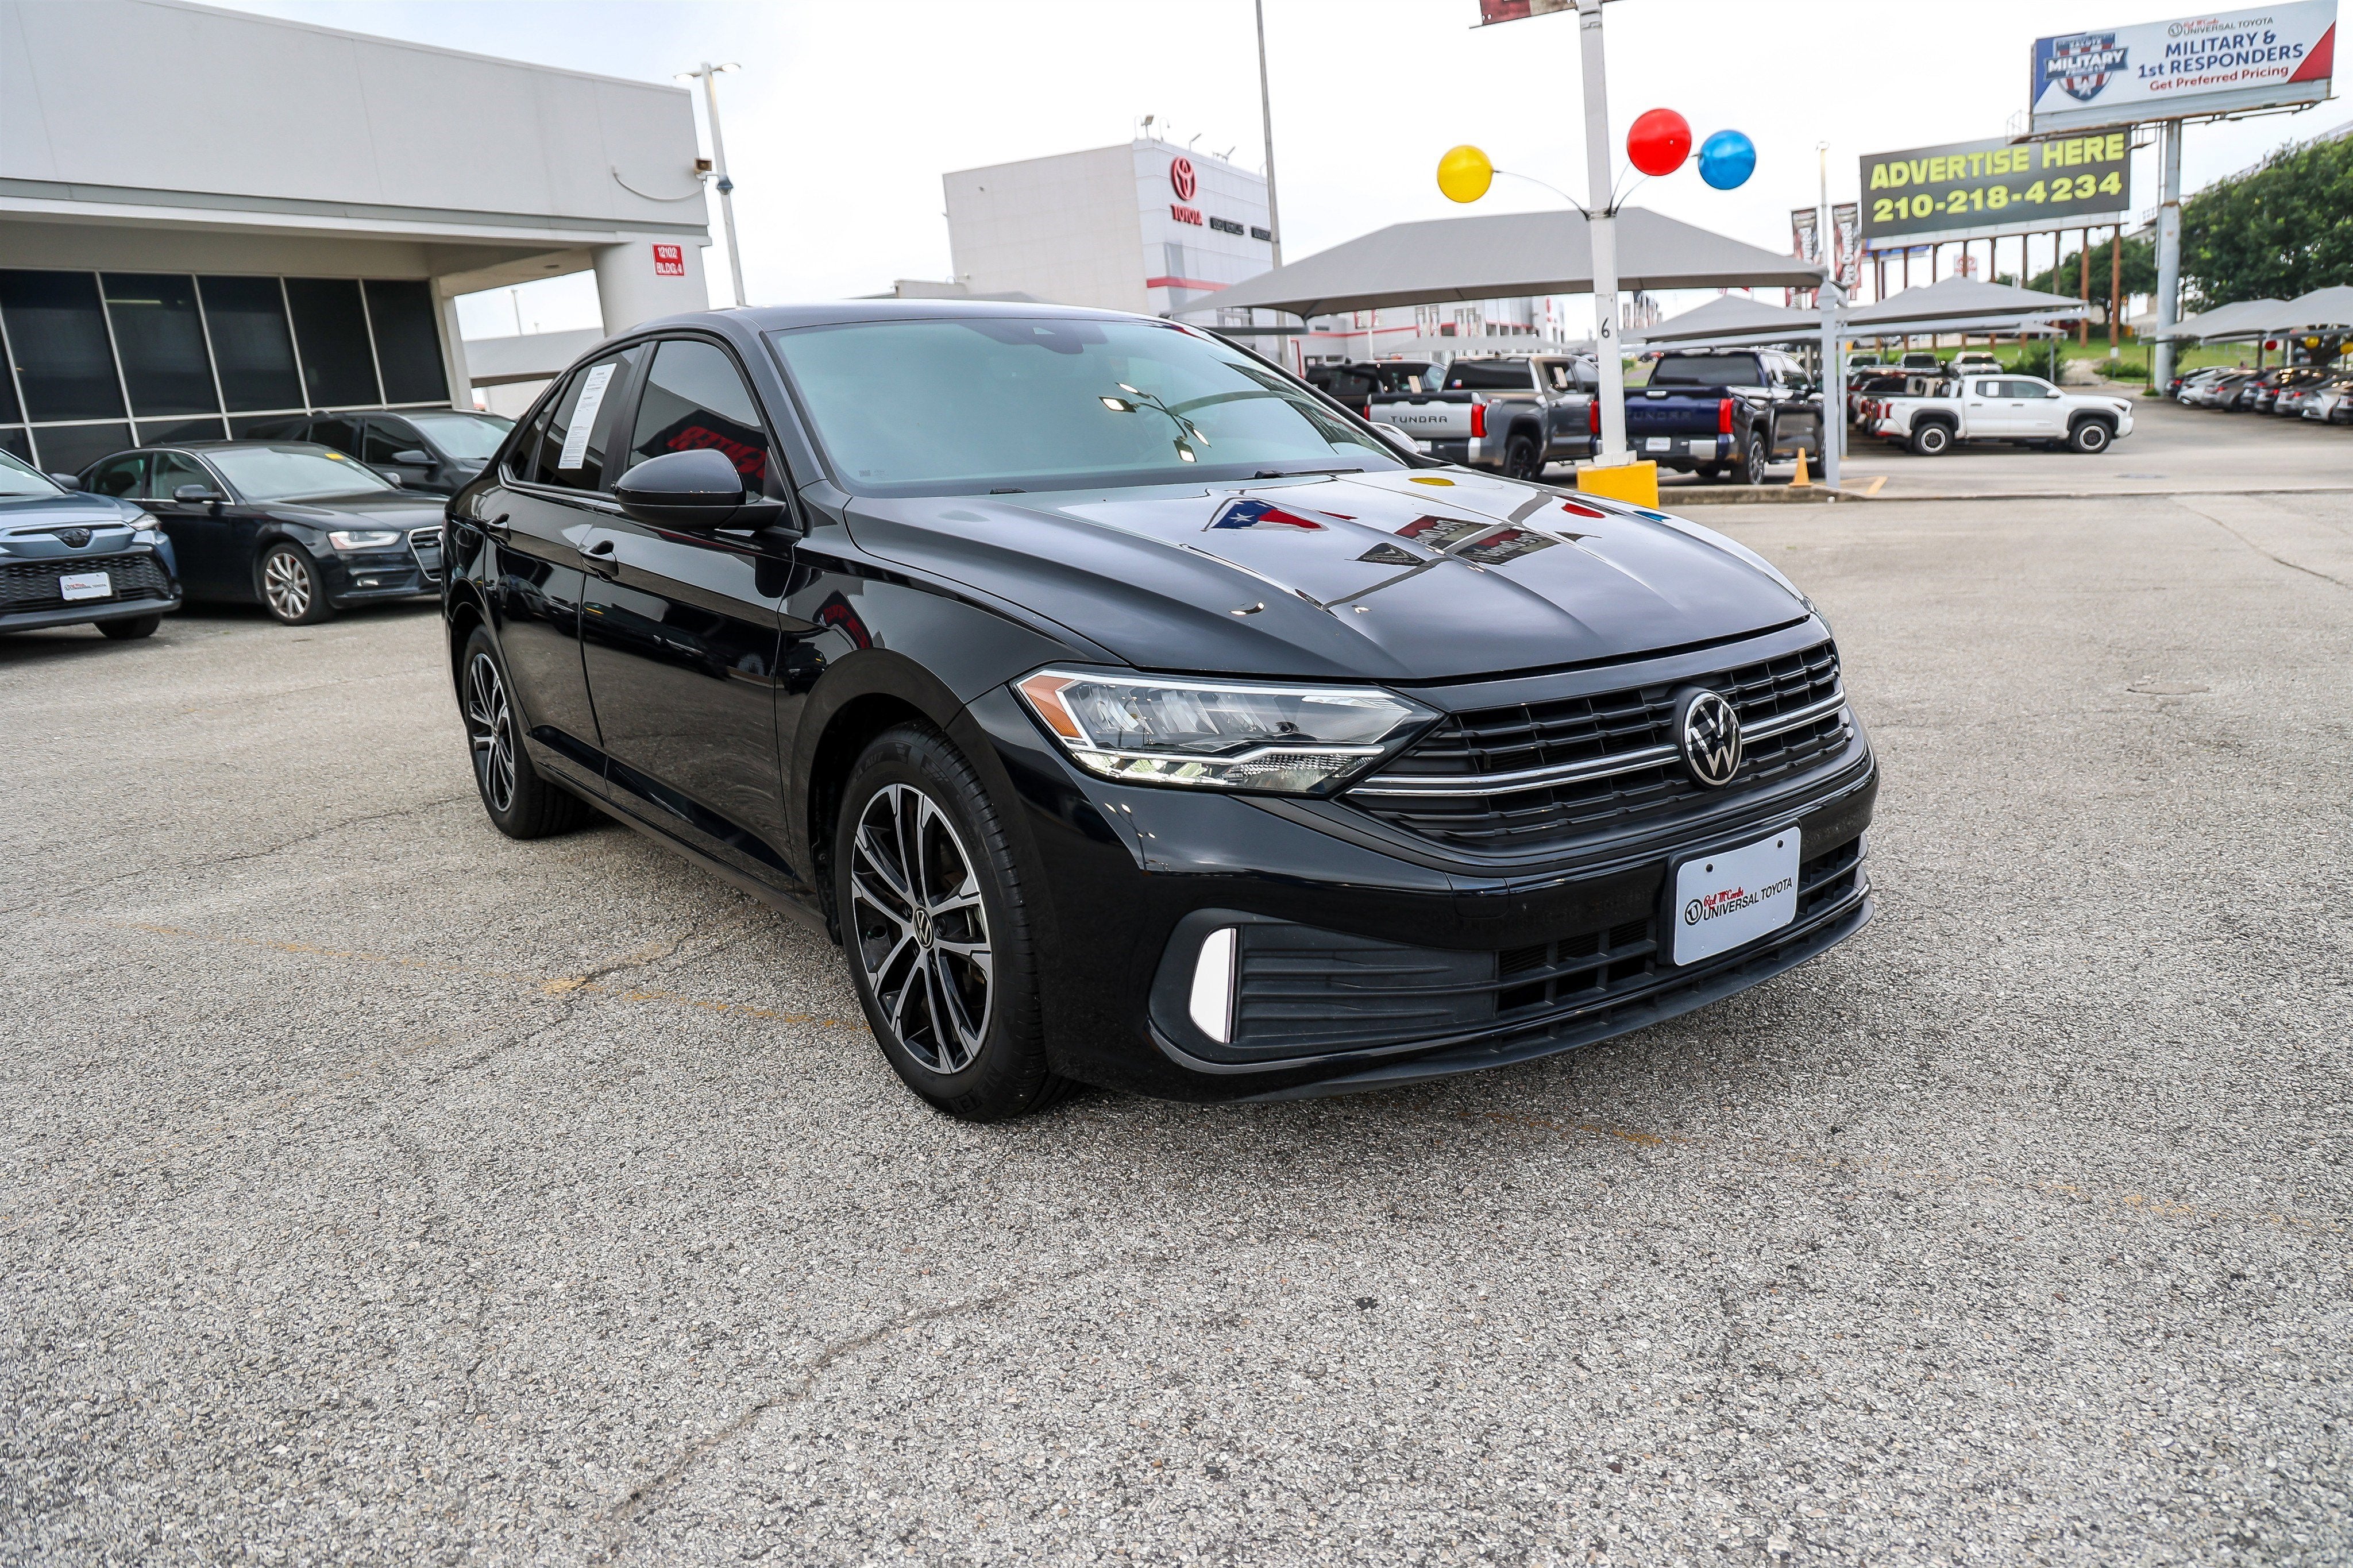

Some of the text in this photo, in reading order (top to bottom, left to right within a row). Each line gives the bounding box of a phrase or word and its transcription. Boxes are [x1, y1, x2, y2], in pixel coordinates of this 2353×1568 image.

[2184, 17, 2273, 35] UNIVERSAL TOYOTA
[2165, 29, 2277, 57] MILITARY &
[2047, 48, 2125, 73] MILITARY
[2138, 43, 2304, 78] 1st RESPONDERS
[2150, 65, 2289, 91] Get Preferred Pricing
[1869, 133, 2125, 190] ADVERTISE HERE
[1873, 171, 2123, 223] 210-218-4234
[1840, 222, 1854, 264] Owned
[1840, 264, 1856, 286] Pre
[1602, 316, 1610, 338] 6
[1703, 877, 1792, 921] UNIVERSAL TOYOTA
[1704, 895, 1716, 909] Red
